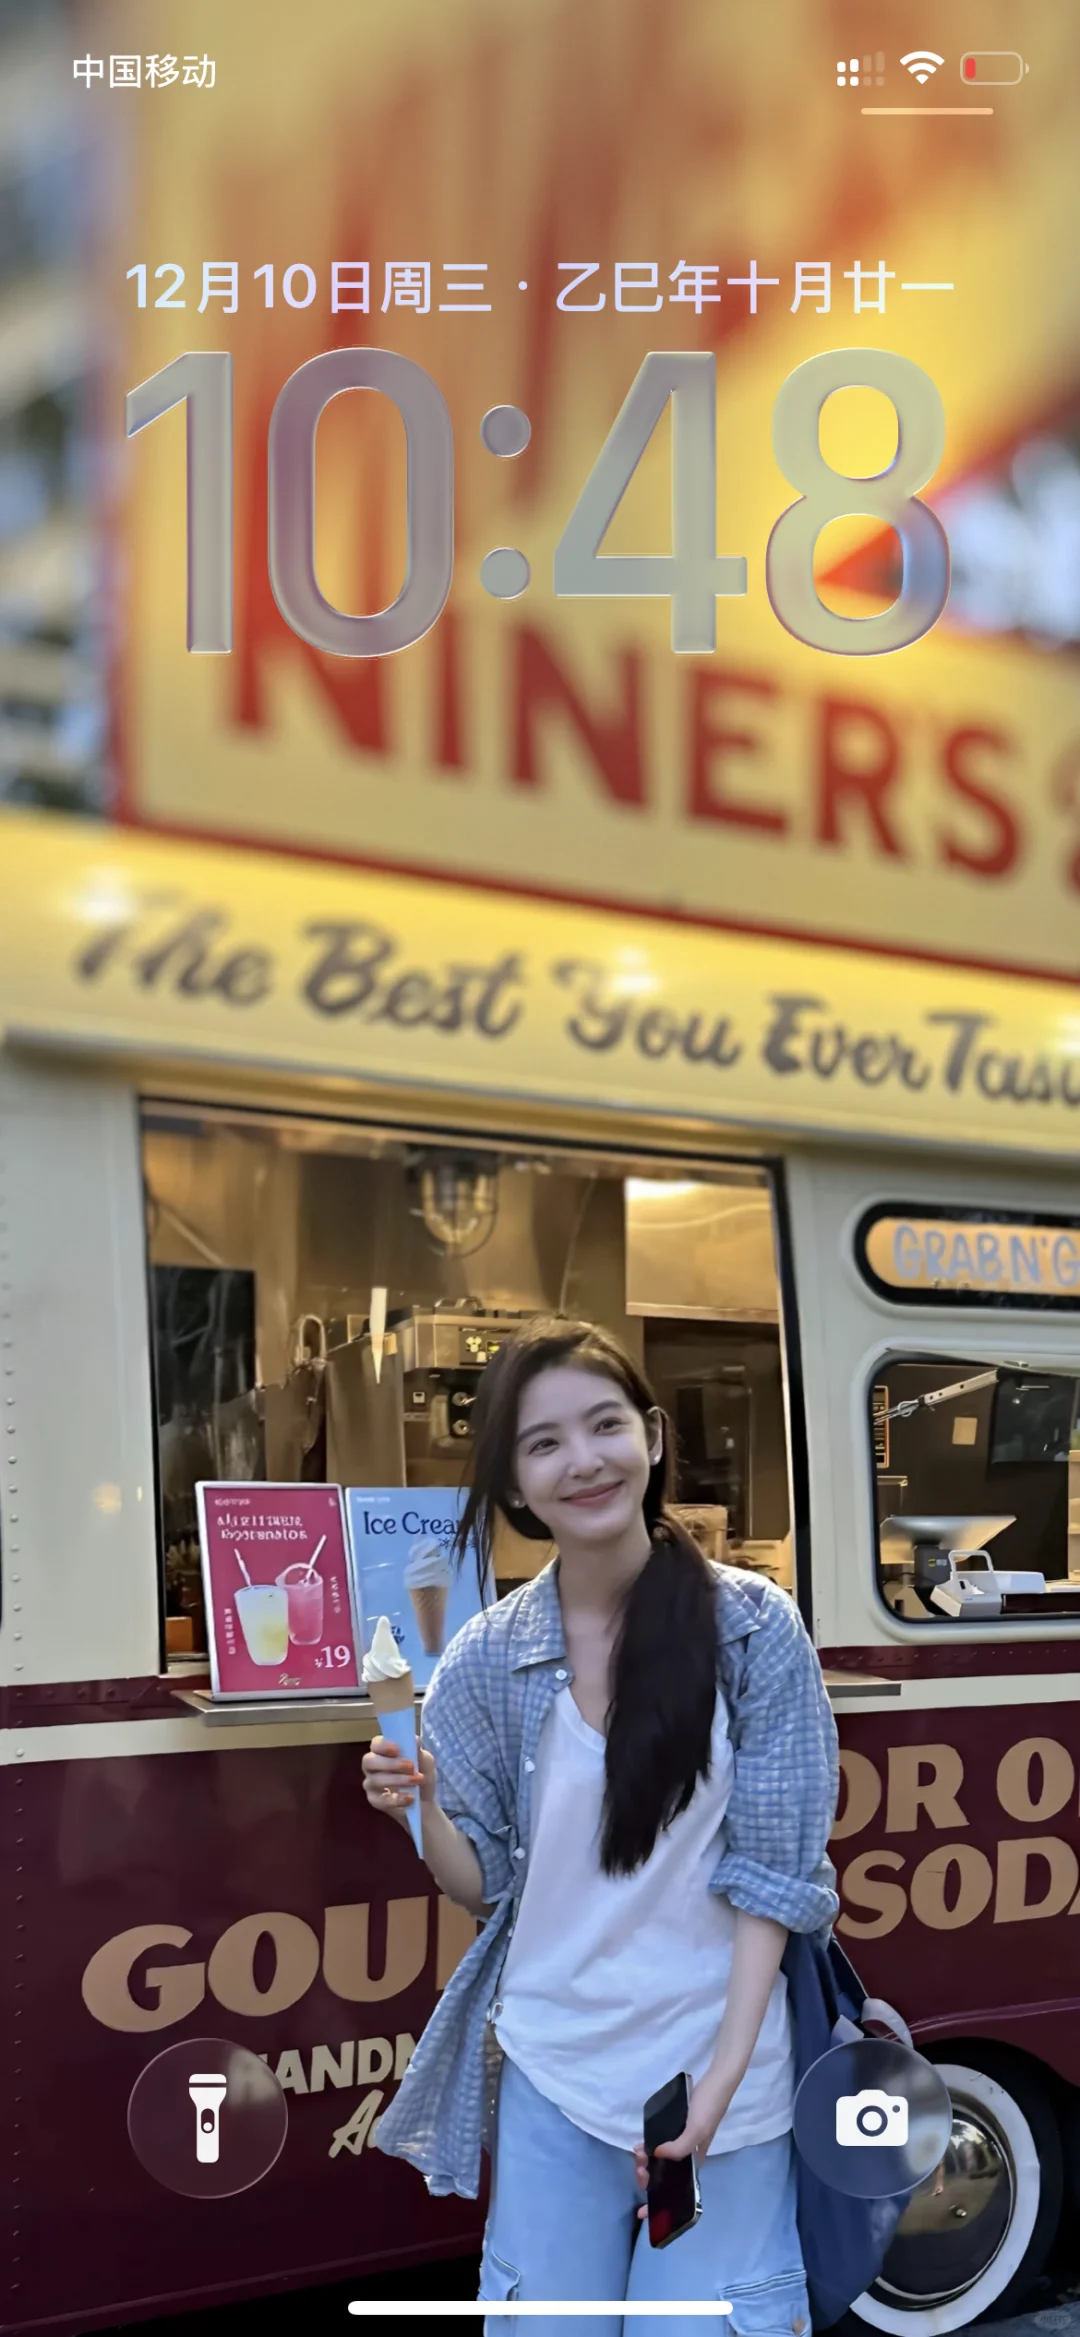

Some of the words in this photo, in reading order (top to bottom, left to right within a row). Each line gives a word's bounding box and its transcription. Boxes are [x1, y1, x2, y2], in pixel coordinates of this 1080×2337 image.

[74, 888, 272, 1008] The
[302, 918, 524, 1040] Best
[552, 958, 744, 1068] You
[763, 994, 932, 1090] Ever
[893, 1224, 1003, 1283] GRAB
[363, 1511, 397, 1535] Ice
[401, 1511, 461, 1535] Crea
[836, 1836, 1080, 1940] SOD
